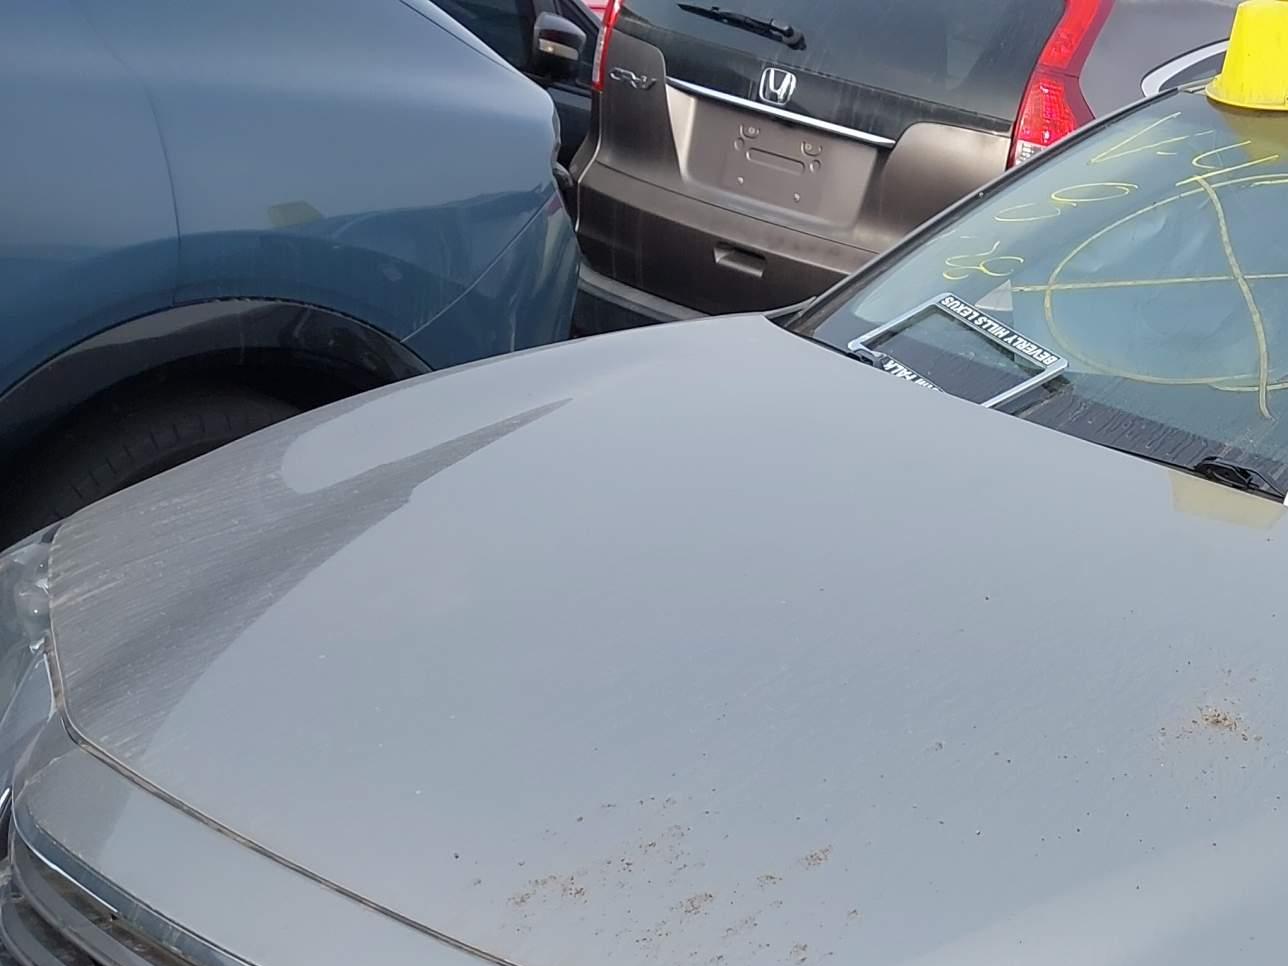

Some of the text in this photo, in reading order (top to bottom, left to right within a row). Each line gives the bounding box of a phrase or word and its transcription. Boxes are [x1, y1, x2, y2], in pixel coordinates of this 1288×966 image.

[941, 296, 1058, 365] BEVERLY HILLS LEXUS
